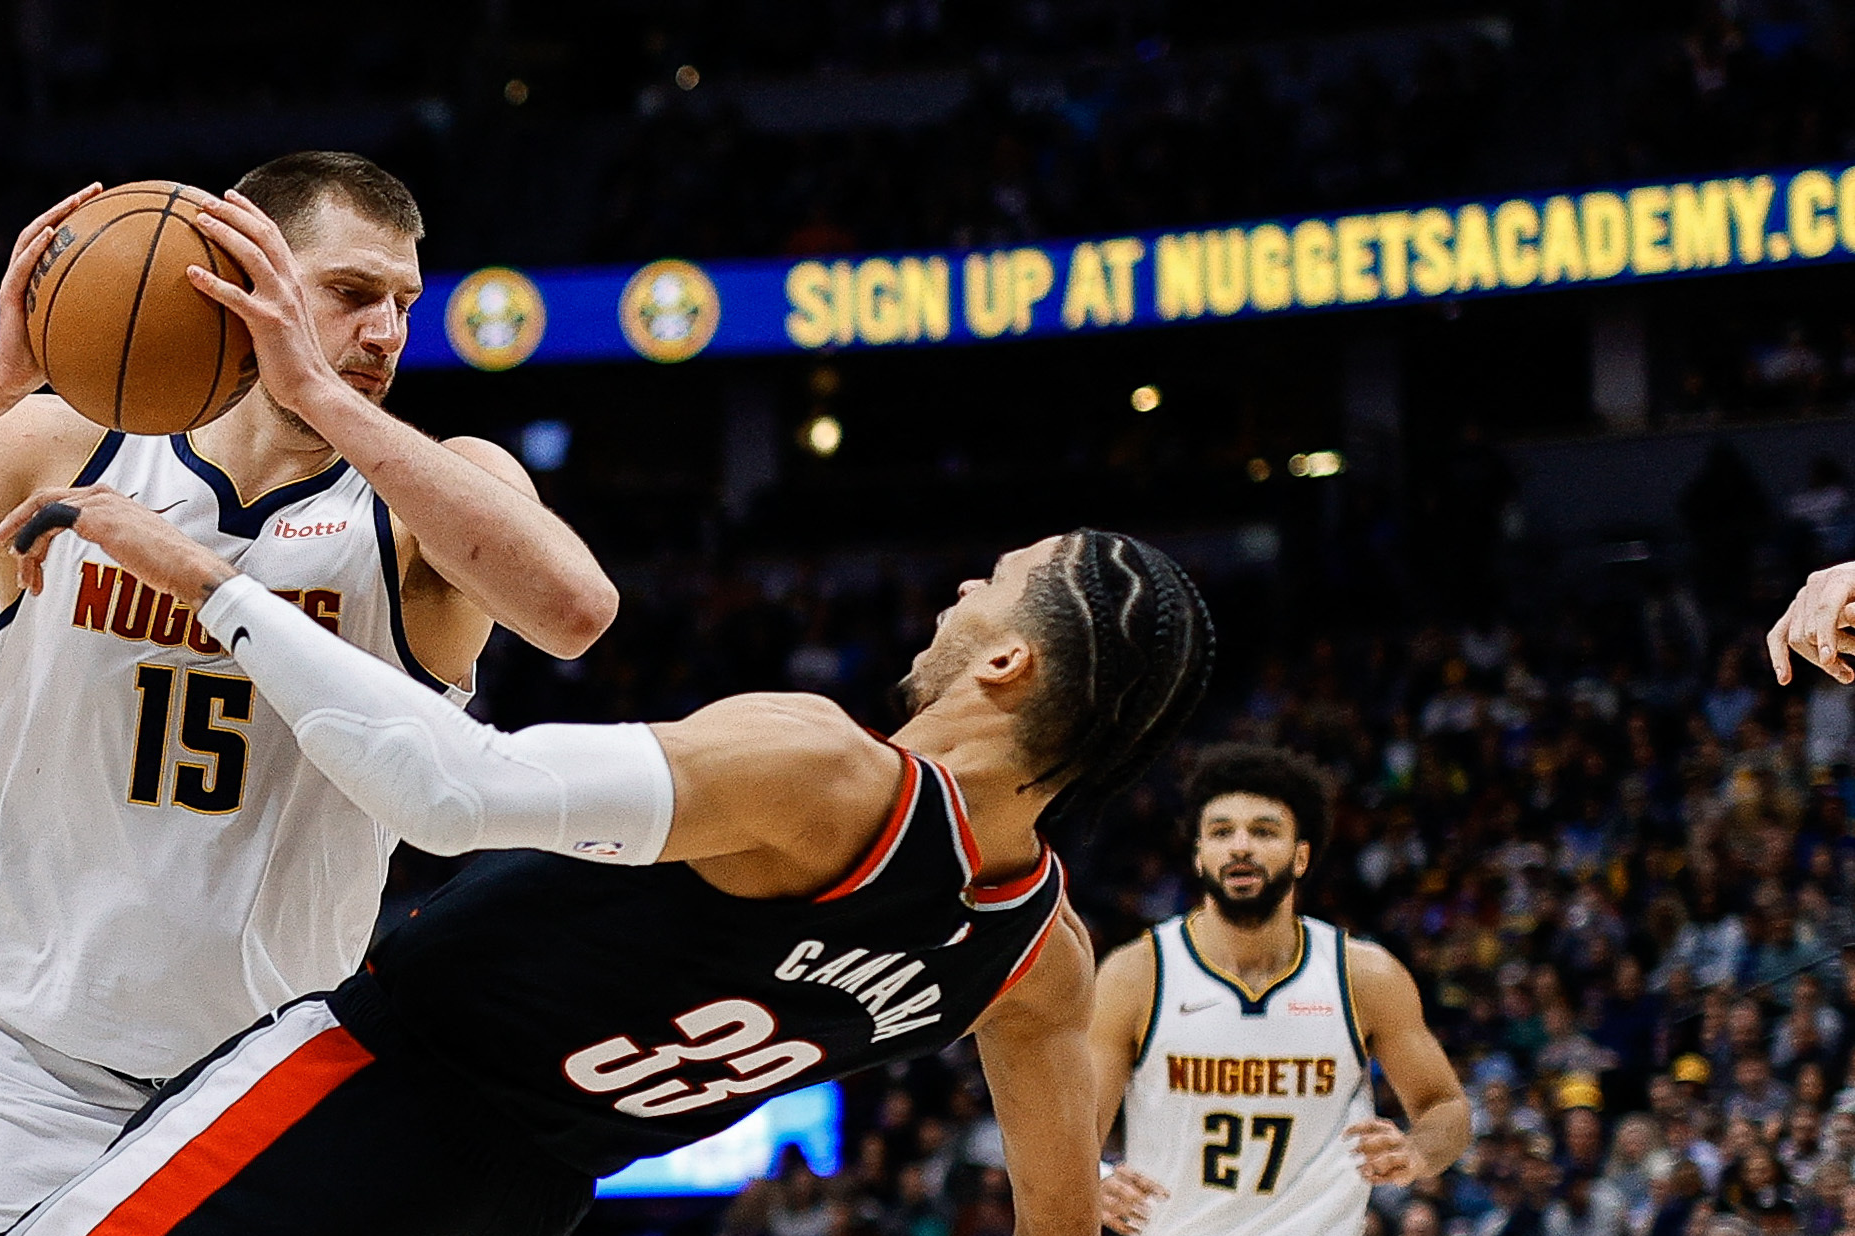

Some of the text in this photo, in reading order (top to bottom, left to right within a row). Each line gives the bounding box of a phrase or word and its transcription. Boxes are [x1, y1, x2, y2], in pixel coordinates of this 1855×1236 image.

[785, 256, 950, 348] SIGN
[964, 248, 1054, 338] UP
[1061, 237, 1144, 330] AT
[274, 518, 348, 539] ibotta
[127, 661, 256, 816] 15
[773, 940, 942, 1045] CAMARA
[561, 996, 827, 1119] 33
[1166, 1054, 1336, 1098] NUGGETS
[1201, 1112, 1295, 1195] 27
